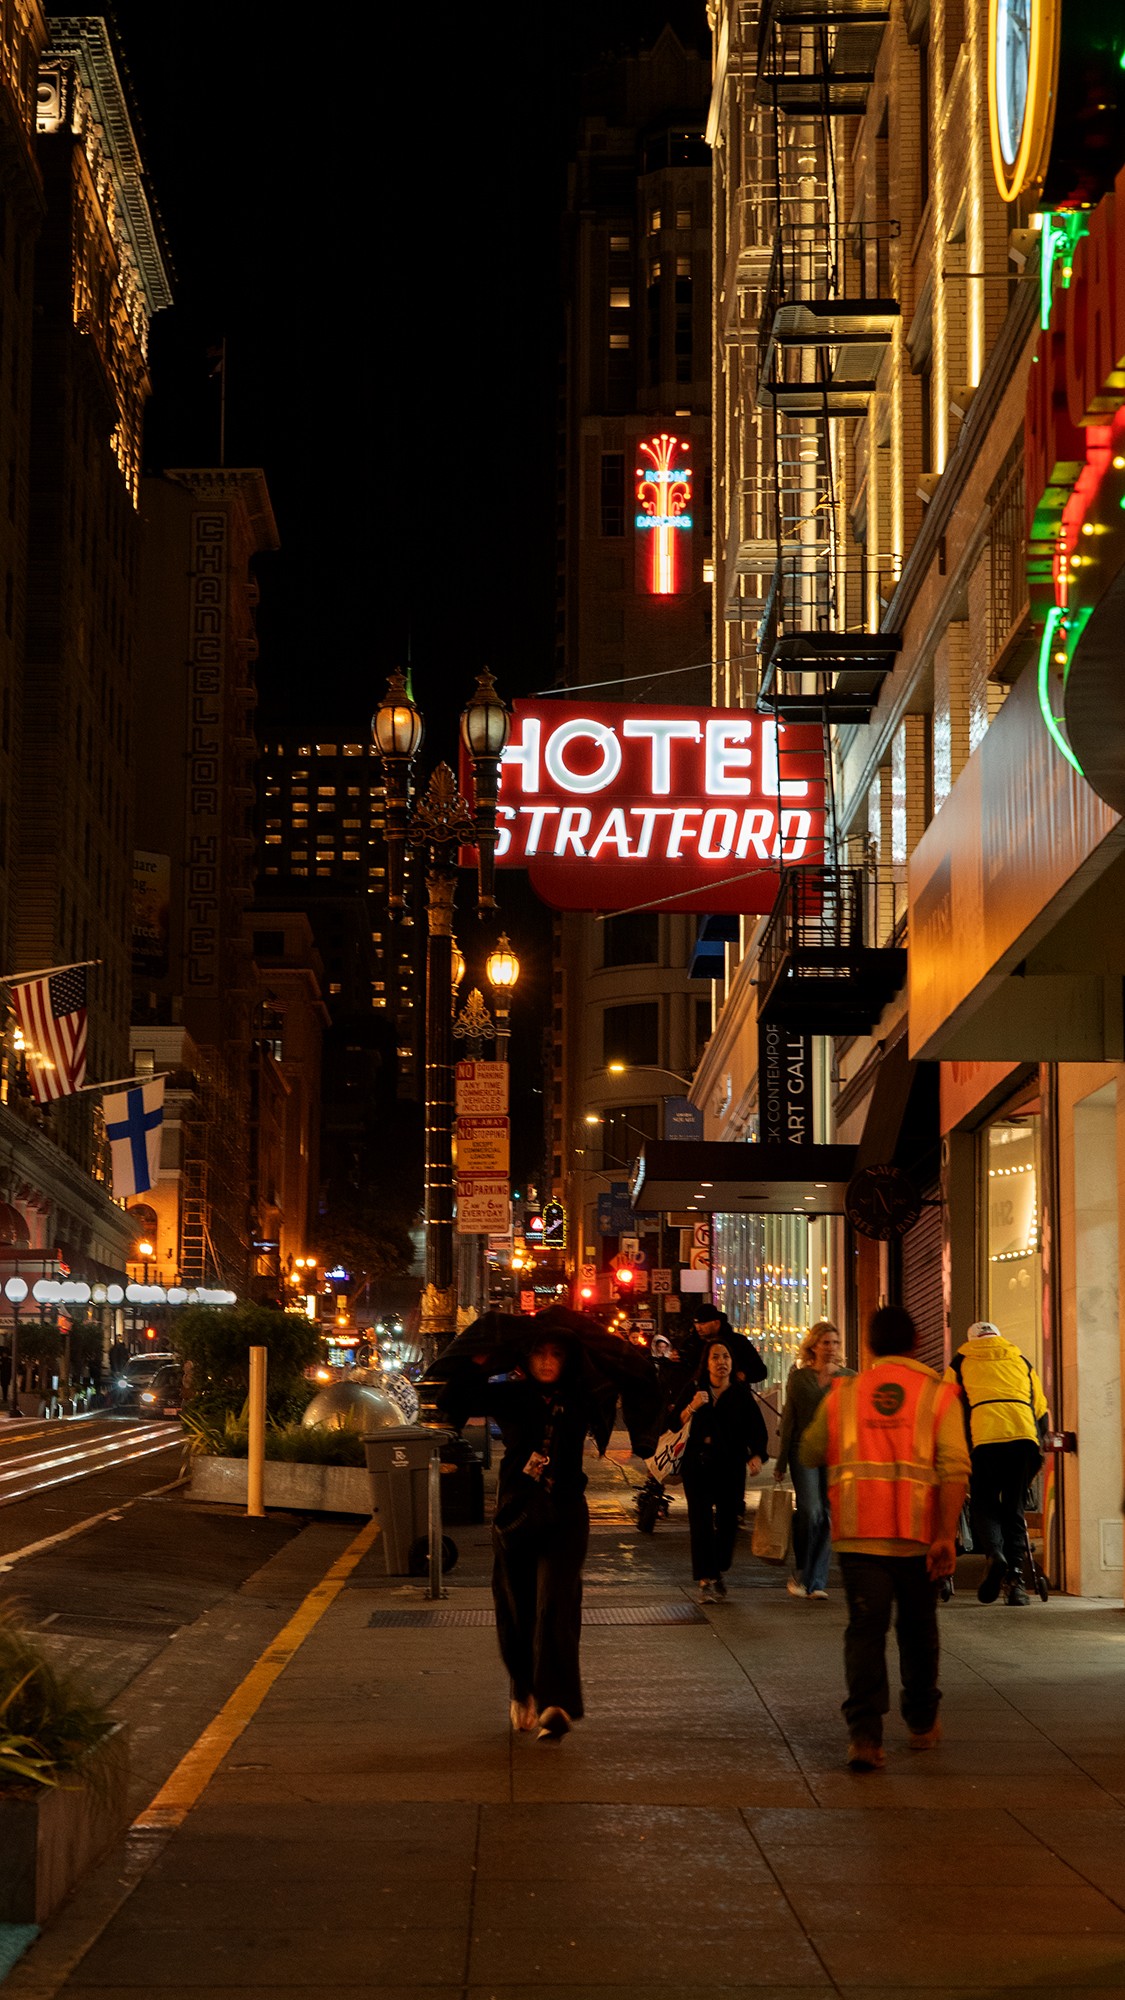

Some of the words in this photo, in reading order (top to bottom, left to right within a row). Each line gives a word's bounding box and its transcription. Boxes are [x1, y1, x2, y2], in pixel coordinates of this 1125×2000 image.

[645, 470, 687, 482] ROOM
[636, 516, 692, 527] DANCING
[191, 514, 225, 815] CHANCELLOR
[498, 718, 808, 797] HOTEL
[494, 806, 812, 861] STRATFORD
[188, 835, 217, 986] HOTEL
[458, 1064, 473, 1079] NO
[458, 1089, 505, 1097] COMMERCIAL
[460, 1118, 504, 1126] TOW-AWAY
[787, 1101, 806, 1145] ART
[457, 1127, 473, 1140] NO
[473, 1129, 506, 1139] STOPPING
[458, 1181, 473, 1196] NO
[473, 1184, 508, 1195] PARKING
[463, 1199, 470, 1209] 2
[487, 1199, 495, 1209] 6
[461, 1209, 503, 1217] EVERYDAY
[654, 1281, 670, 1291] 20
